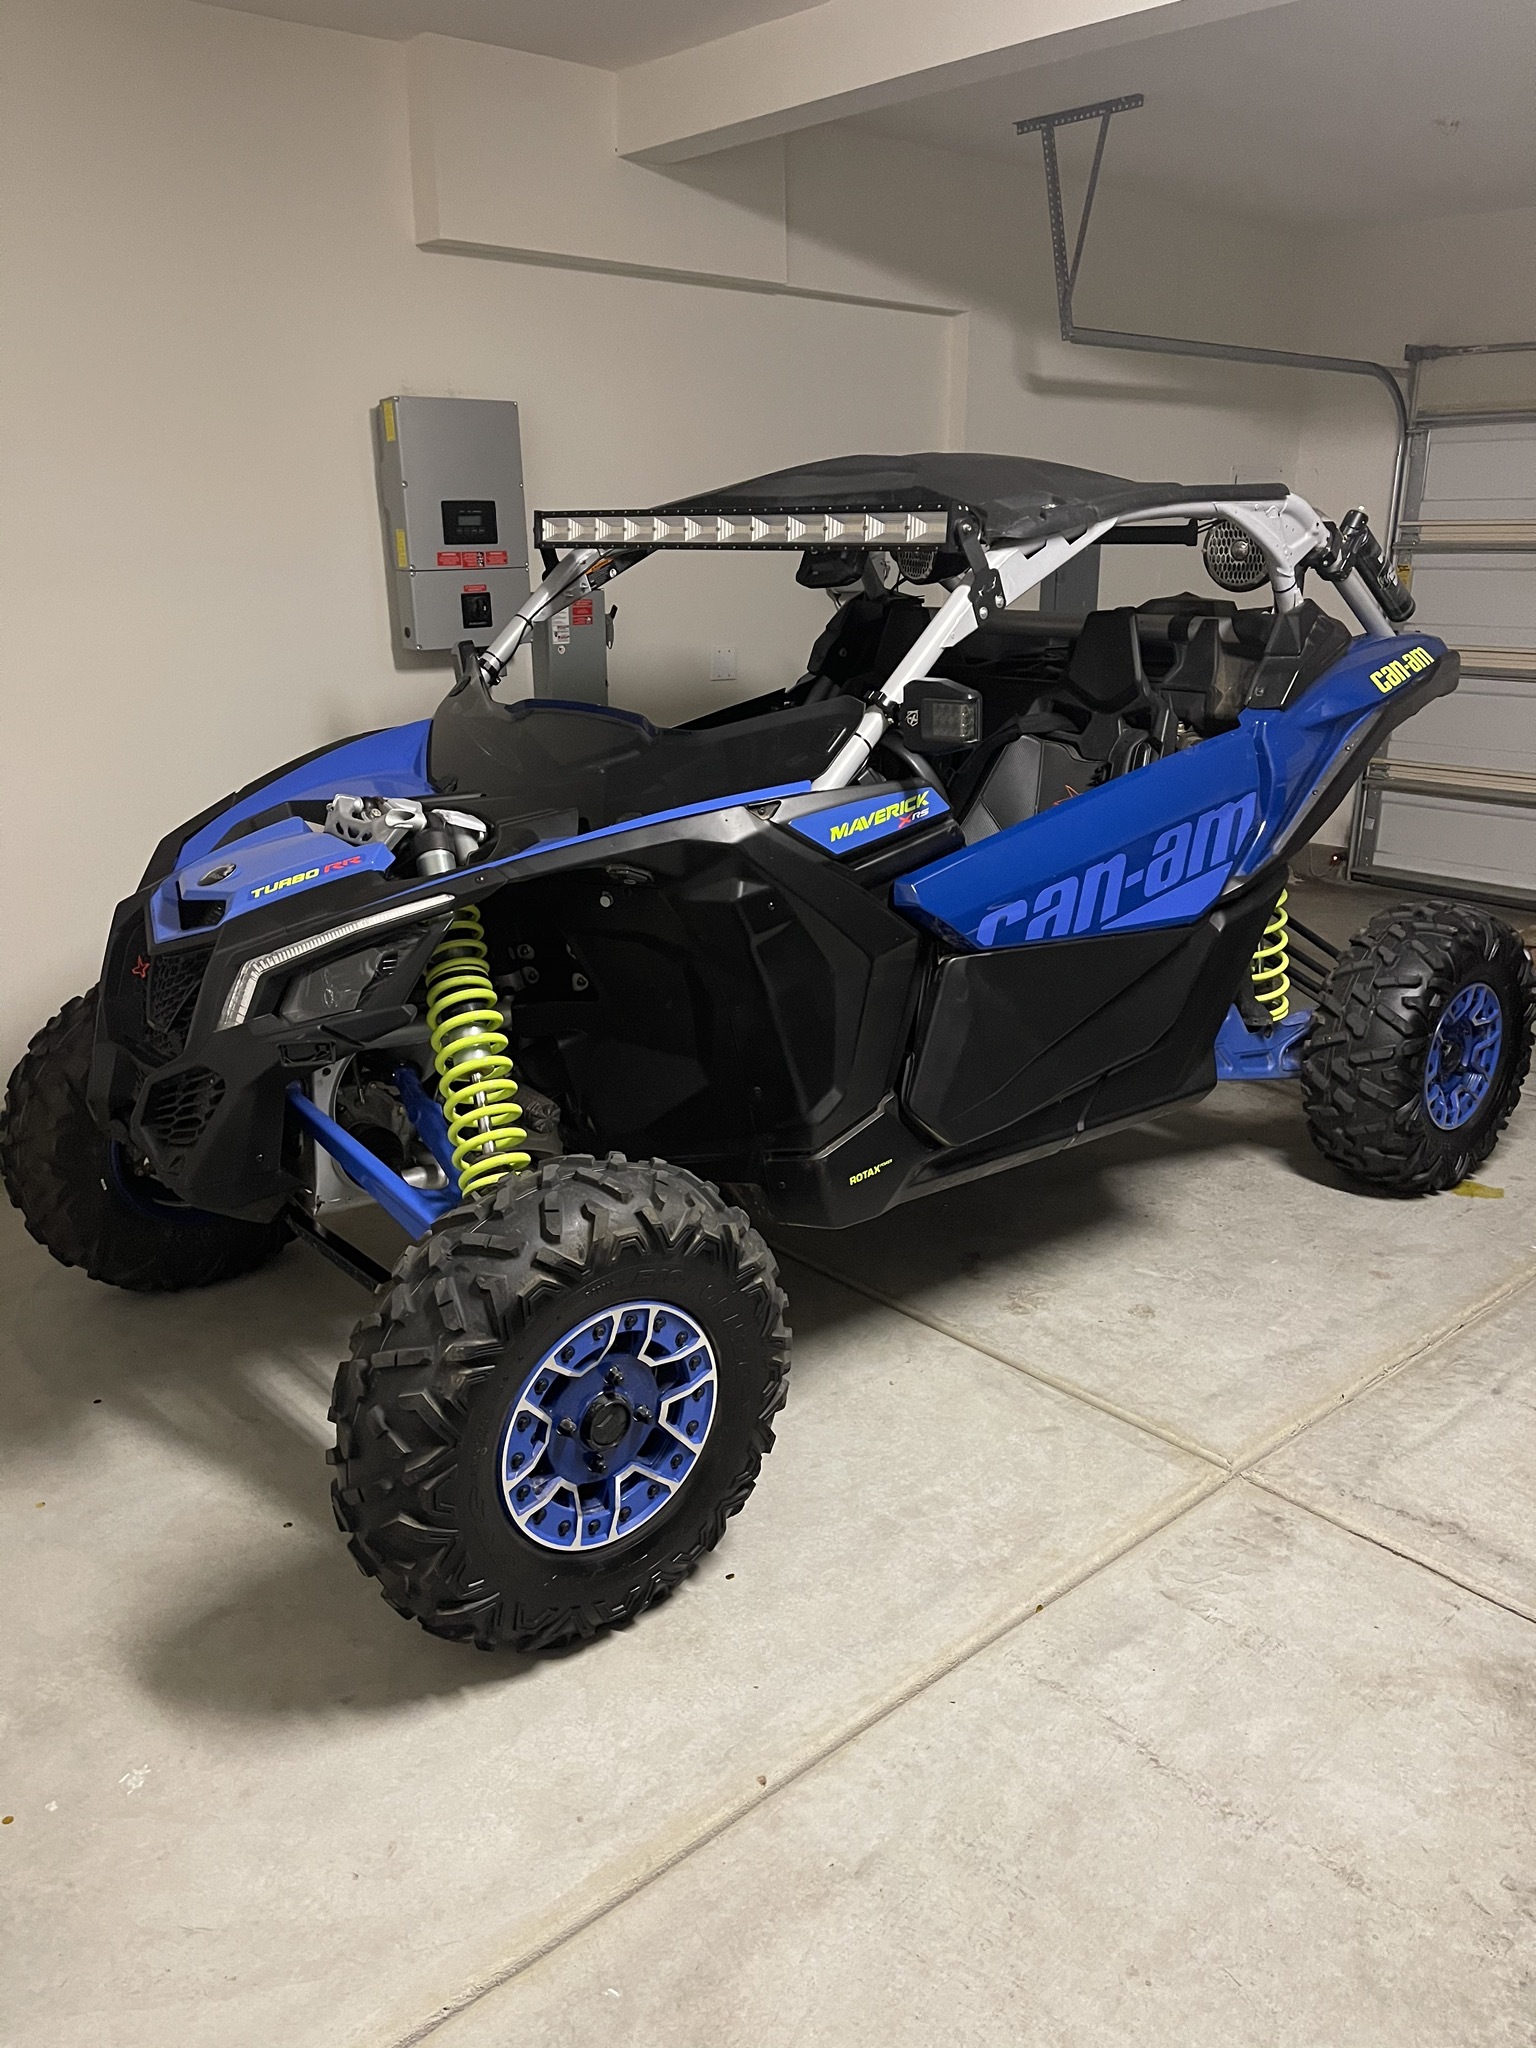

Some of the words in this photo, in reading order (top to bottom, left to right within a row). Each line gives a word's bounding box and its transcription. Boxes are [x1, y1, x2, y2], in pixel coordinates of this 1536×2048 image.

[1369, 646, 1435, 693] can-am
[830, 790, 930, 842] MAVERICK
[251, 868, 320, 898] TURBO
[324, 856, 360, 873] RR
[849, 1165, 880, 1185] ROTAX
